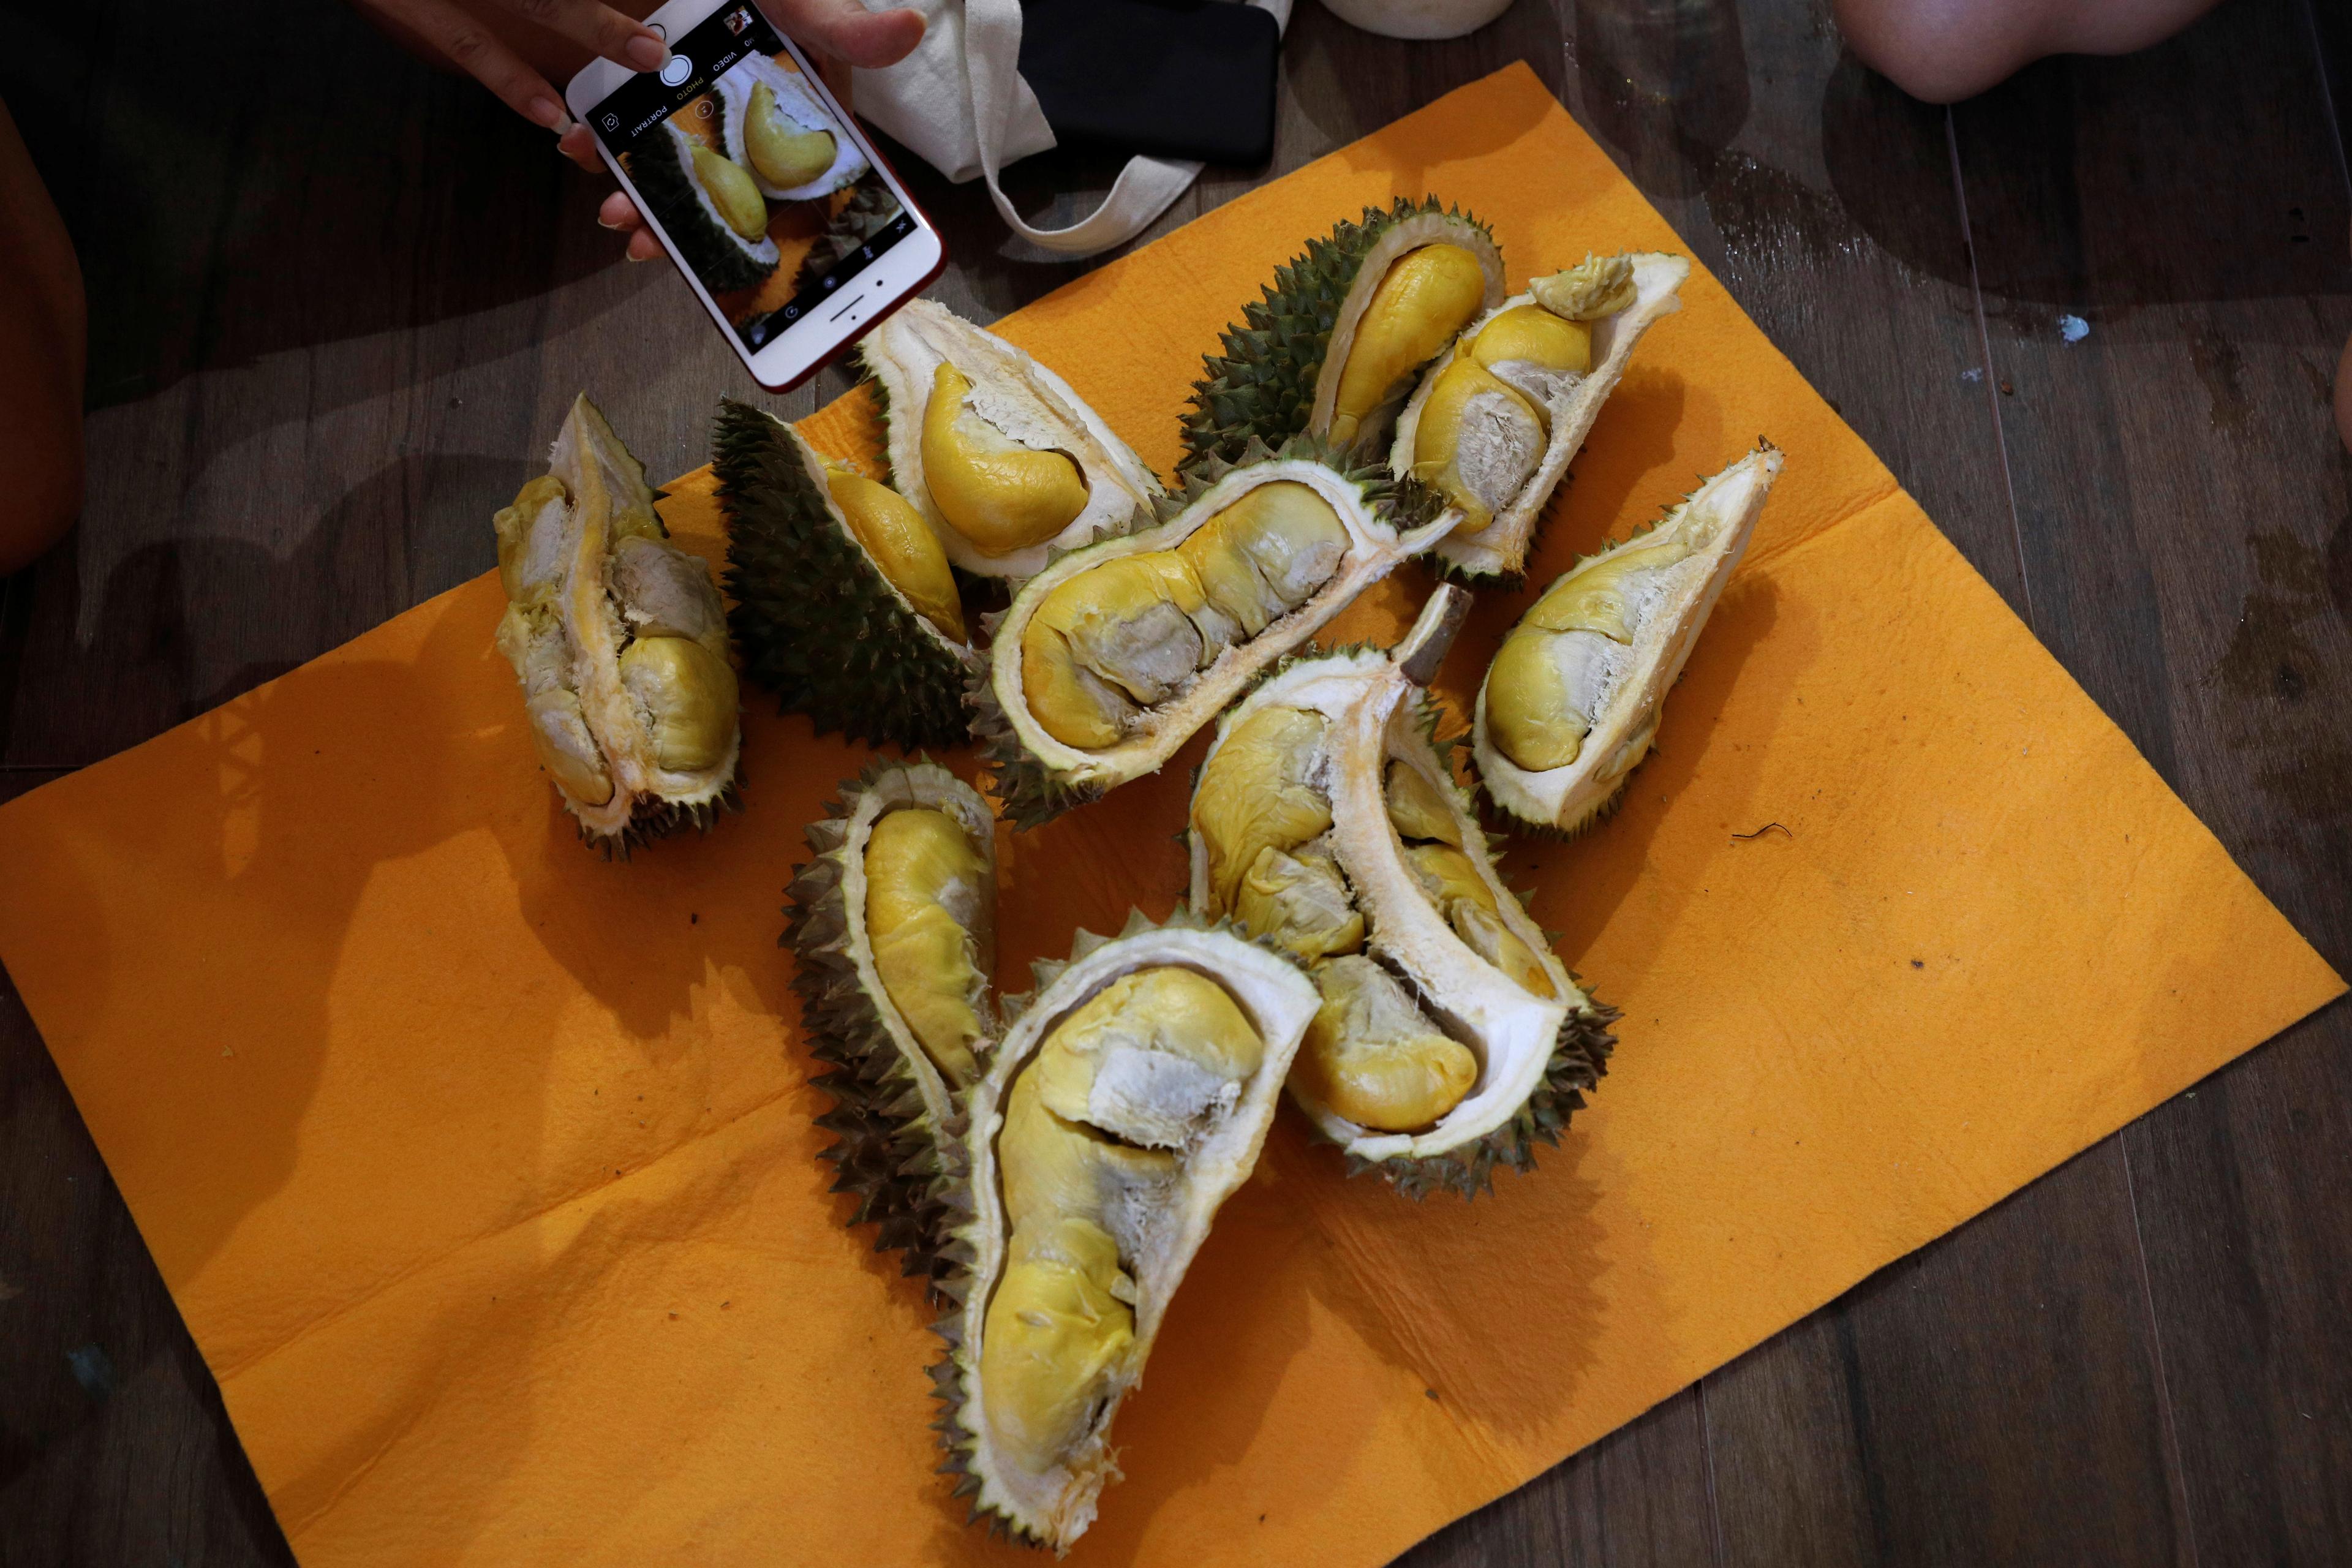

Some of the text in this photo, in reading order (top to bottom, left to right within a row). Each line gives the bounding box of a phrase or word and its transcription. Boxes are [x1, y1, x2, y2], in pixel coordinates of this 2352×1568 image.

[713, 51, 737, 71] VIDEO
[676, 77, 704, 100] PHOTO
[631, 105, 668, 137] PORTRAIT
